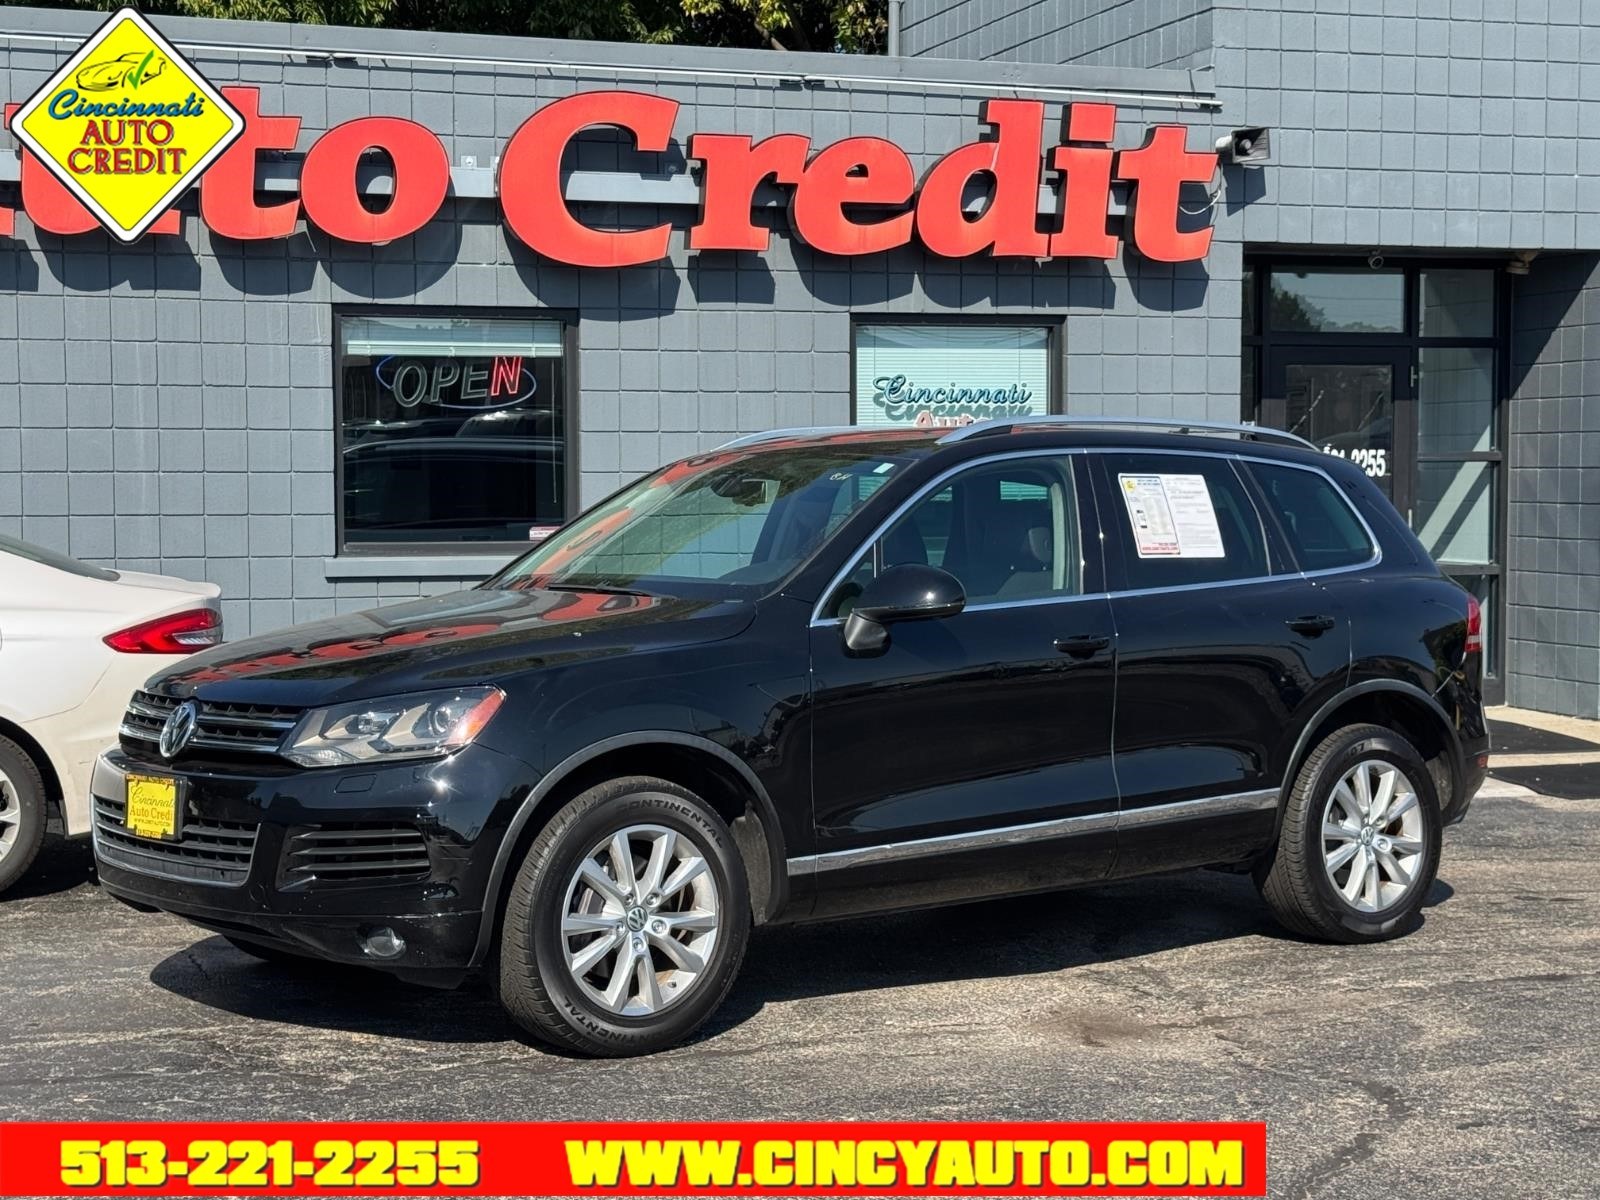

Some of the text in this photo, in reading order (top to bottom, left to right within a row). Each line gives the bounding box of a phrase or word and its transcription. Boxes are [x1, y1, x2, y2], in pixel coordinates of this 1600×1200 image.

[500, 90, 1219, 268] Credit
[393, 355, 522, 408] OPEN
[873, 374, 1033, 405] Cincinnati
[129, 805, 149, 818] Auto
